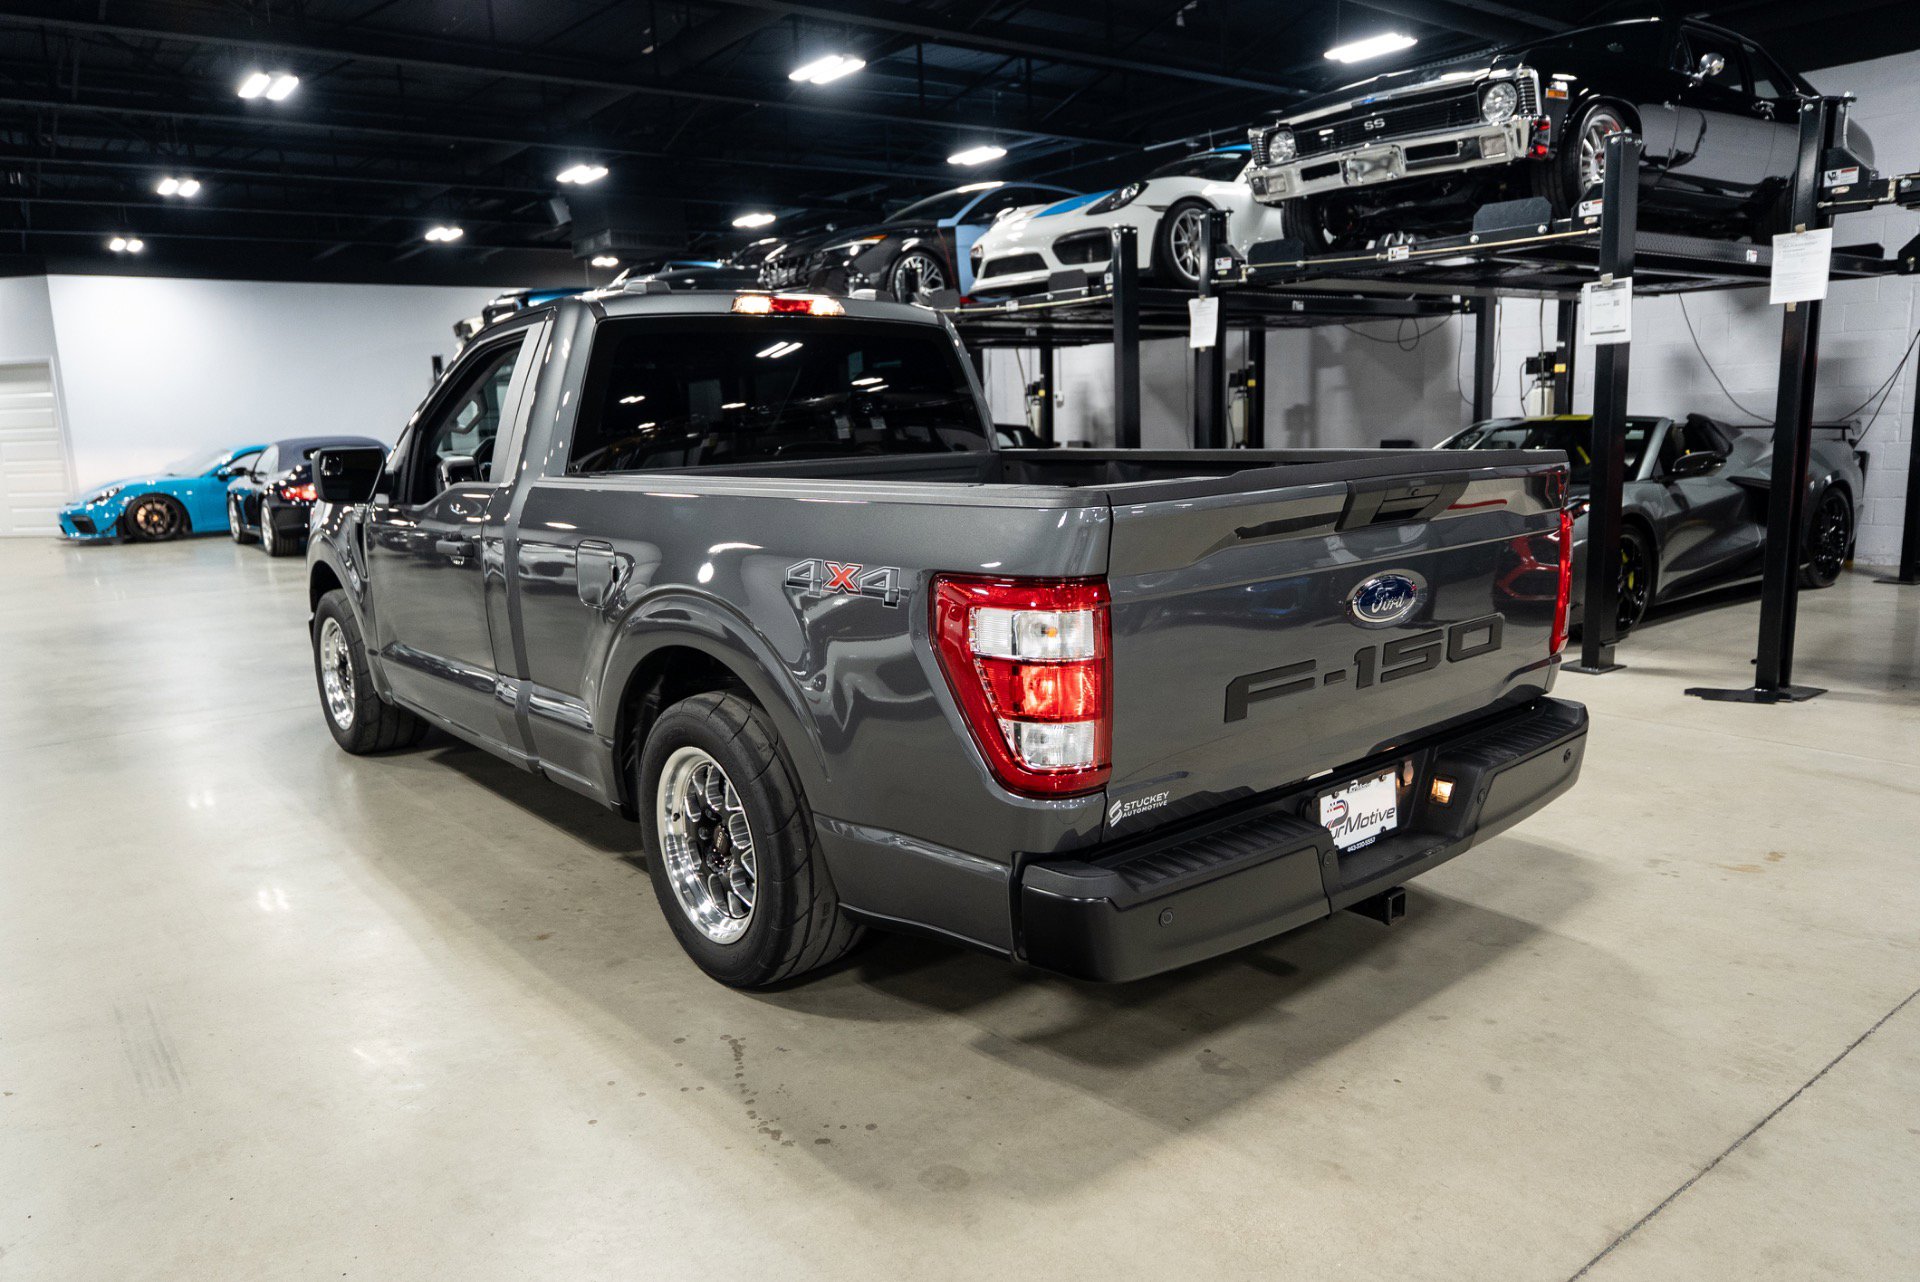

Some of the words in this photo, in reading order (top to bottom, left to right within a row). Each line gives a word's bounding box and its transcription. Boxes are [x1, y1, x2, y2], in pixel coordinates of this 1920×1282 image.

[1364, 118, 1385, 131] SS
[1371, 585, 1406, 613] Ford
[1224, 612, 1505, 723] F-150
[1122, 799, 1168, 819] AUTOMOTIVE
[1123, 790, 1170, 812] STUCKEY
